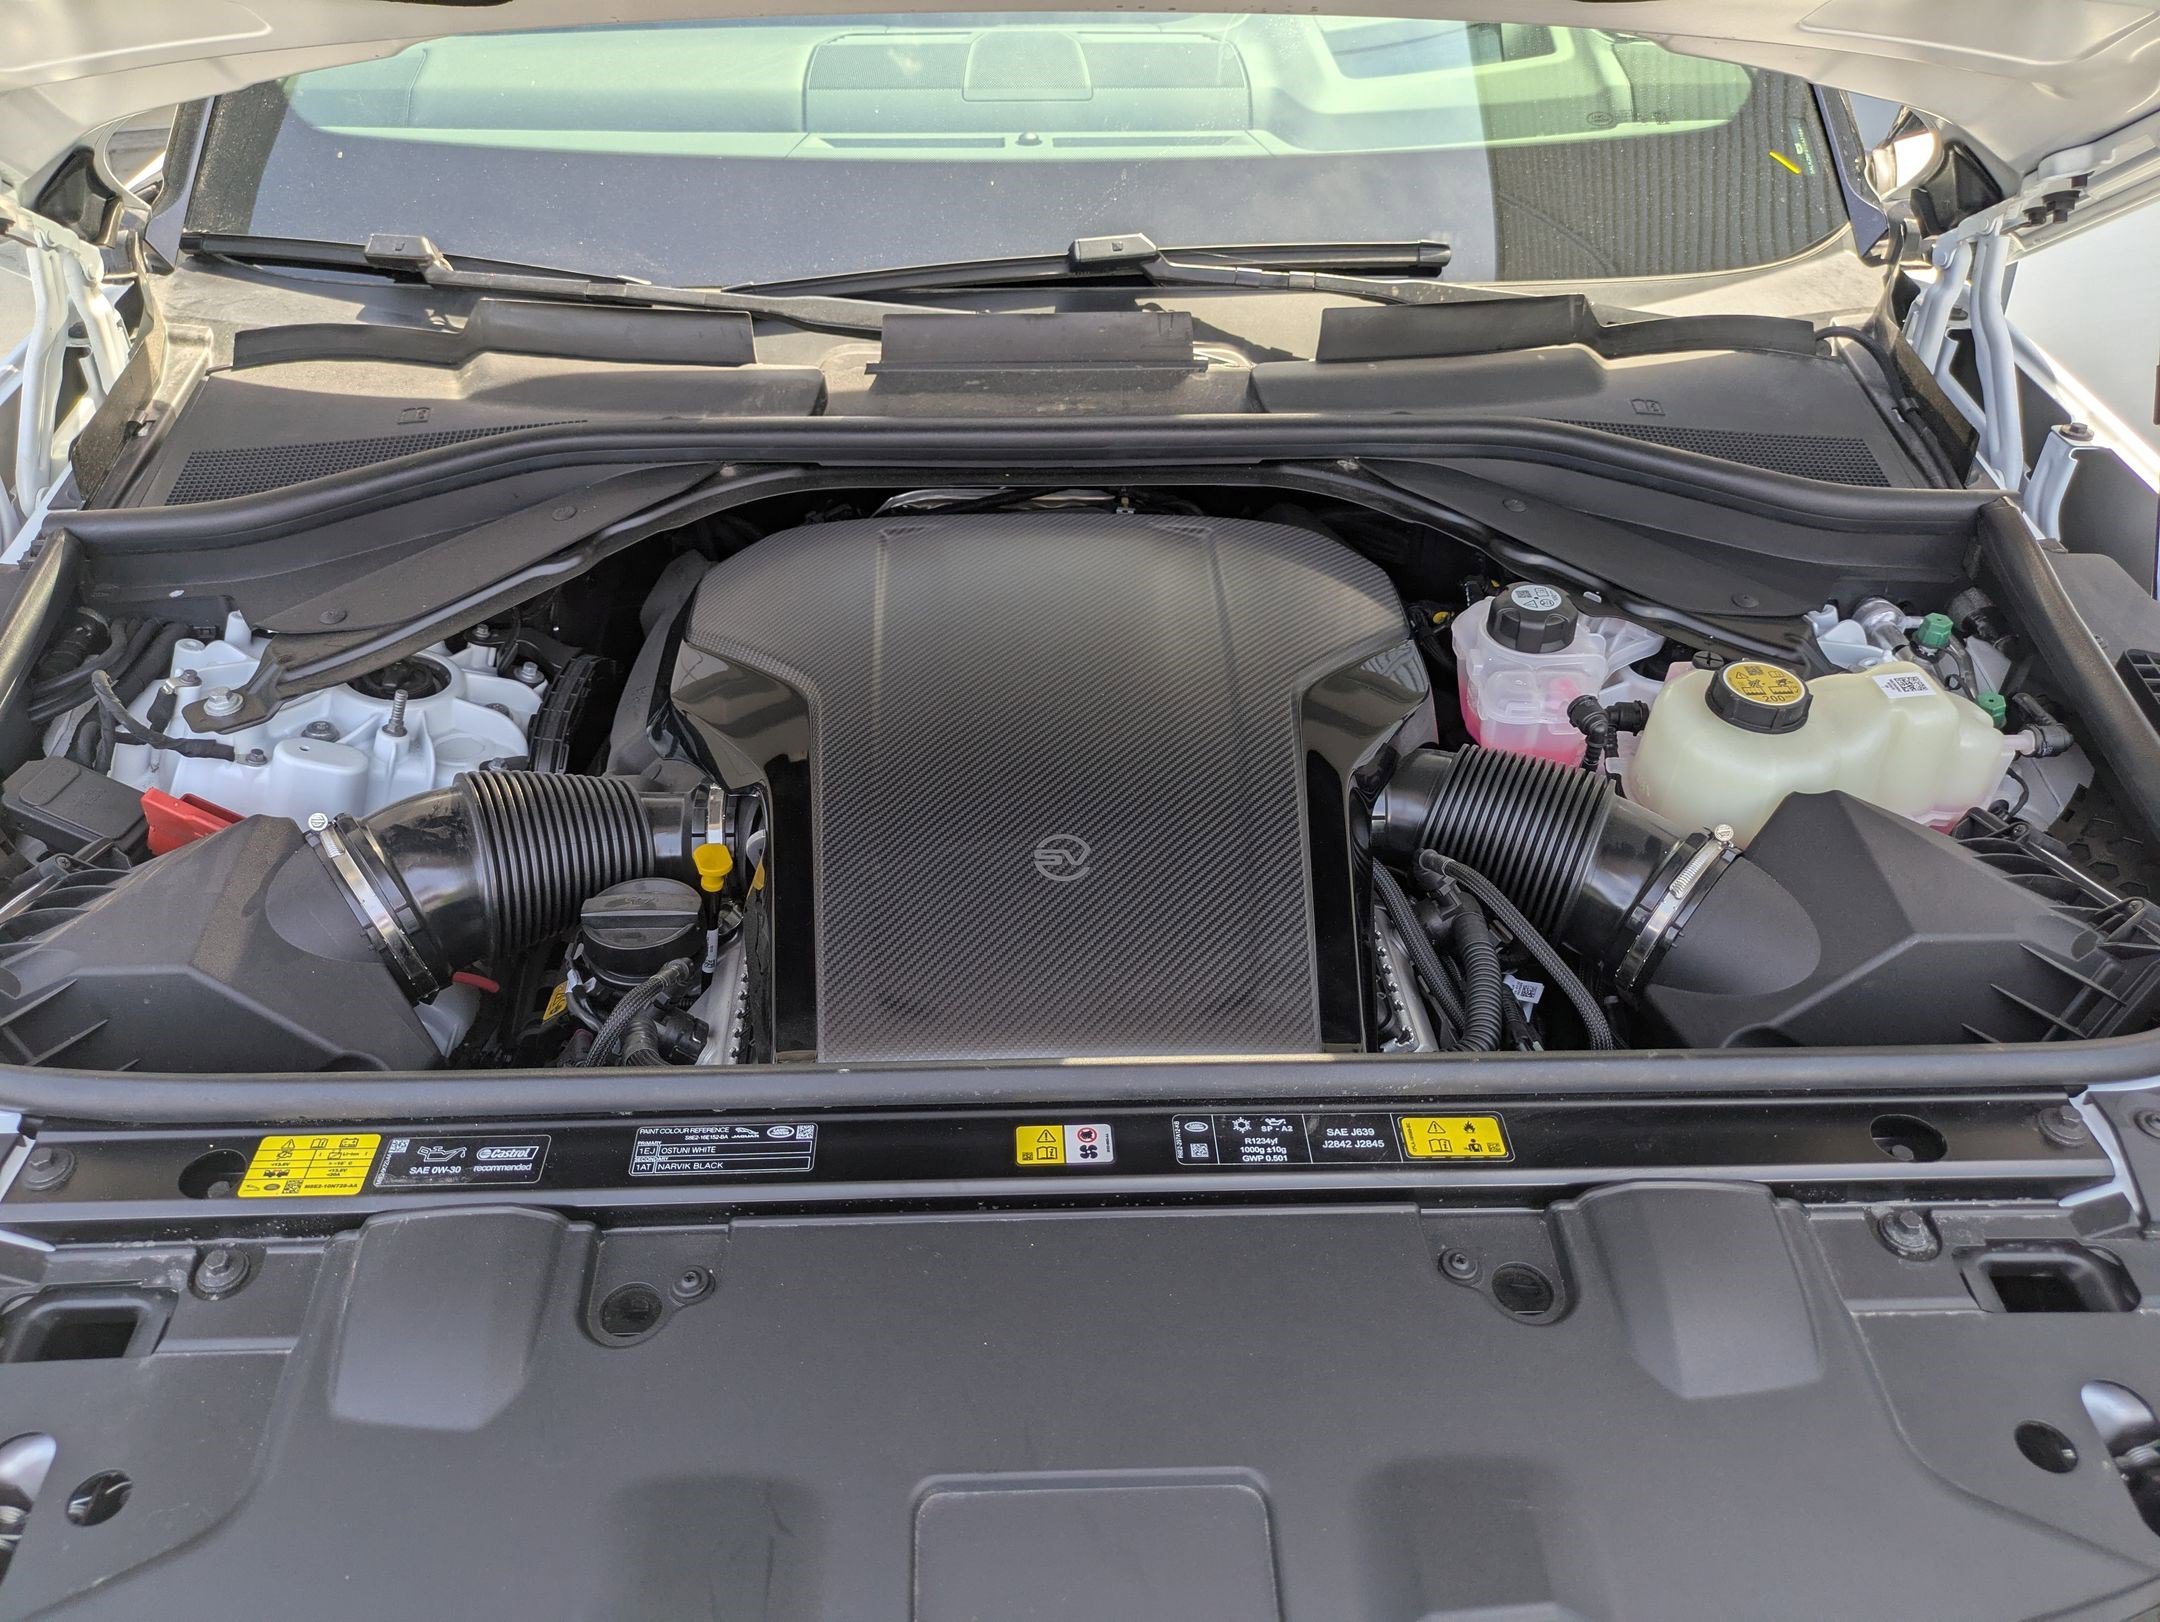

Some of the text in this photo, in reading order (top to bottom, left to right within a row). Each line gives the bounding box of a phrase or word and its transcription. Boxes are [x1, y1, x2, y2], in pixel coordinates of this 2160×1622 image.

[1764, 694, 1786, 703] 200
[660, 1127, 690, 1135] COLOUR
[690, 1126, 730, 1134] REFERENCE
[1326, 1128, 1375, 1137] SAE J639
[1244, 1138, 1279, 1146] R1234yf
[1322, 1139, 1385, 1148] J2842 J2845
[490, 1149, 530, 1159] Castrol
[640, 1147, 656, 1155] 1EJ
[661, 1146, 717, 1155] OSTUNI WHITE
[1266, 1146, 1287, 1154] ±10g
[410, 1166, 462, 1174] SAE 0W-30
[473, 1163, 533, 1173] recommended
[636, 1163, 651, 1171] 1AT
[657, 1161, 724, 1170] NARVIK BLACK
